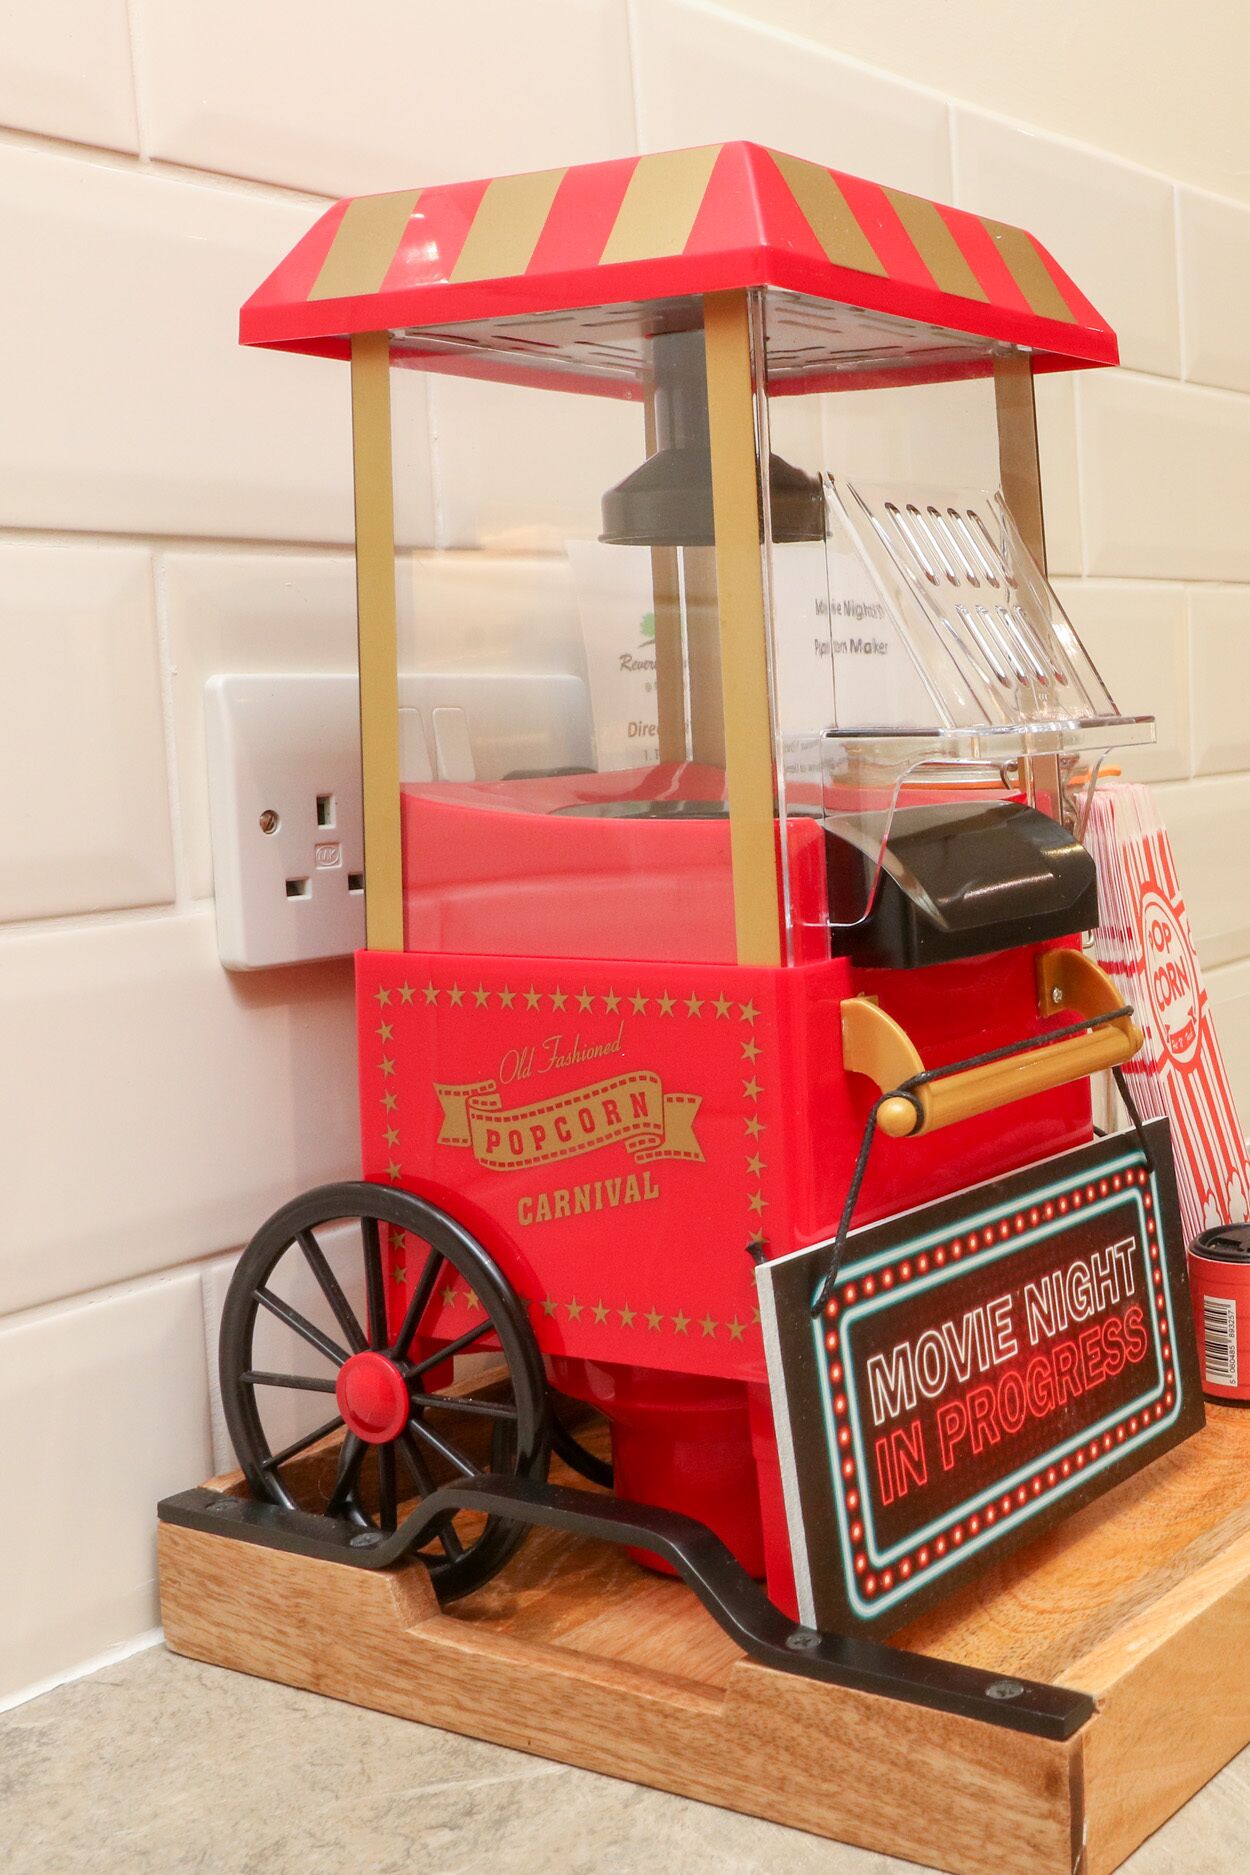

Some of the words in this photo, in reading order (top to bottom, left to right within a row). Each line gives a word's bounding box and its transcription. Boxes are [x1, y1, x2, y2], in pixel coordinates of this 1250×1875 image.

[849, 638, 888, 655] Maker
[628, 721, 659, 738] Dire
[1153, 955, 1191, 1012] CORN
[499, 1046, 536, 1085] Old
[537, 1019, 625, 1073] Fashioned
[485, 1090, 649, 1156] POPCORN
[517, 1170, 660, 1227] CARNIVAL
[866, 1295, 1019, 1427] MOVIE
[1024, 1235, 1137, 1346] NIGHT
[874, 1419, 929, 1507] IN
[936, 1305, 1150, 1472] PROGRESS
